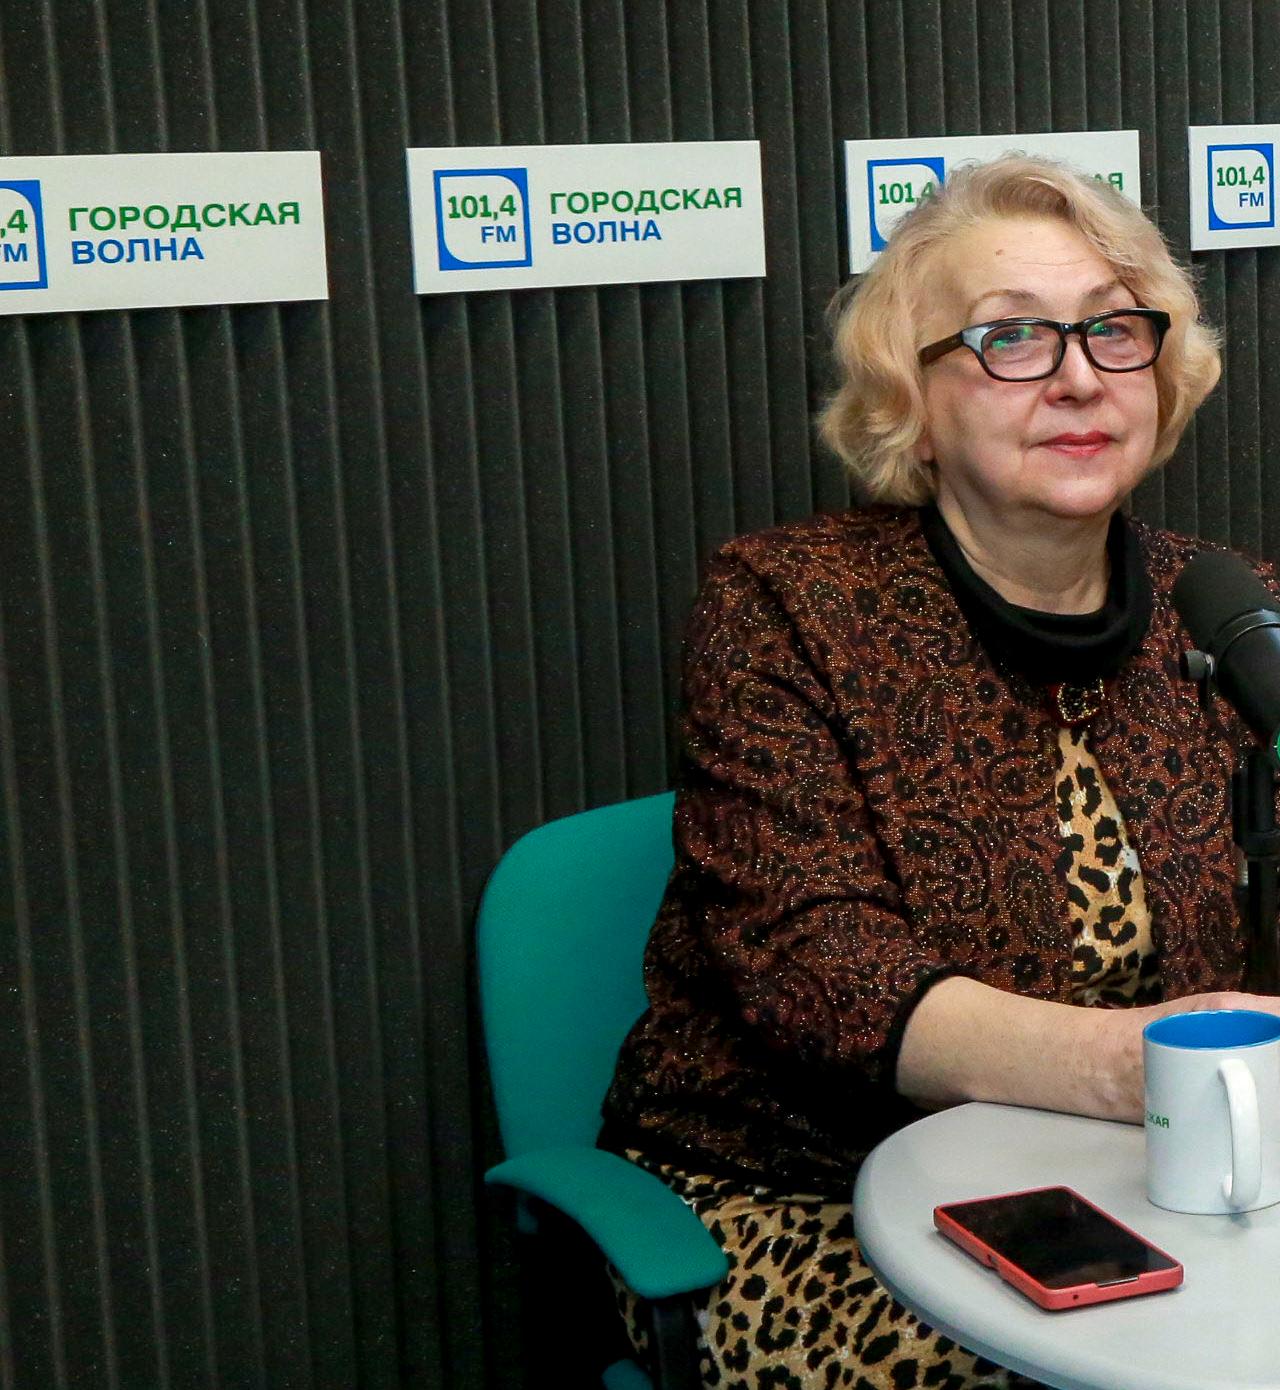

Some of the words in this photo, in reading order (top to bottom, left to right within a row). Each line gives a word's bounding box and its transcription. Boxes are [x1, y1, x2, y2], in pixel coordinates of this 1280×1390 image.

[1216, 165, 1265, 189] 101,4
[447, 192, 517, 221] 101,4
[550, 186, 743, 216] ГОРОДСКАЯ
[1239, 192, 1264, 208] FM
[68, 201, 301, 232] ГОРОДСКАЯ
[480, 224, 517, 243] FM
[551, 219, 662, 245] ВОЛНА
[0, 243, 28, 262] M
[71, 236, 205, 265] ВОЛНА
